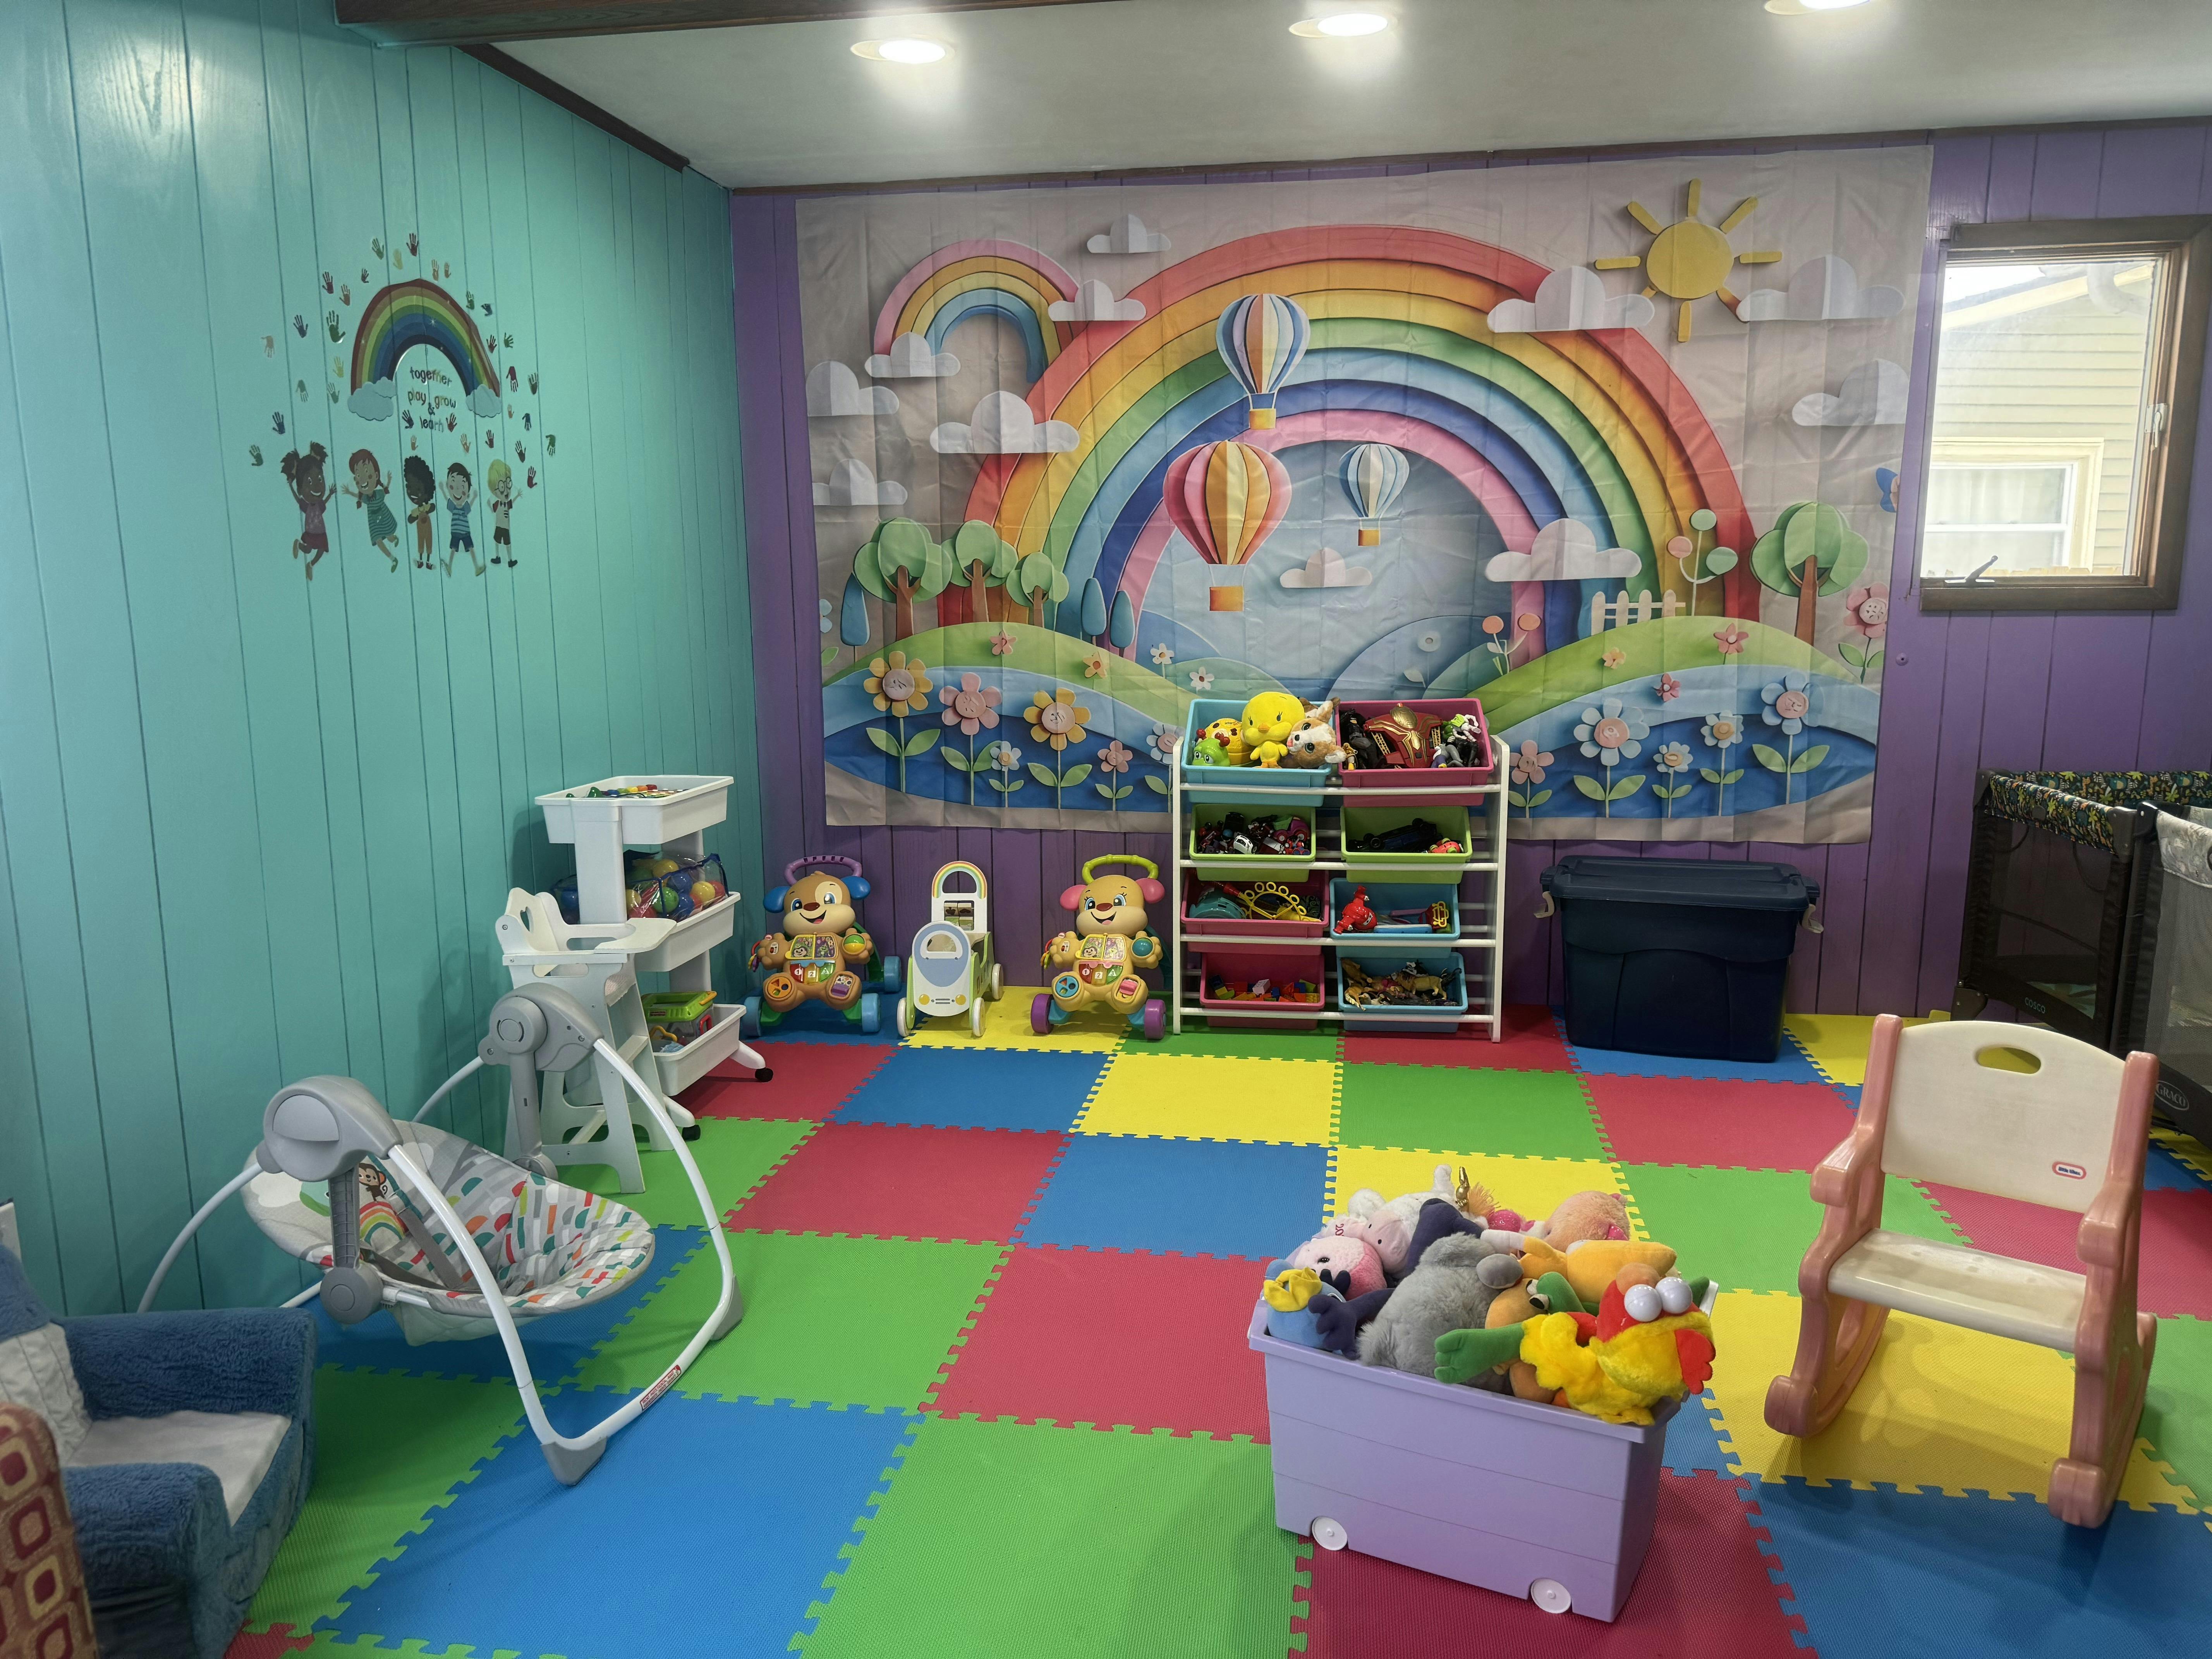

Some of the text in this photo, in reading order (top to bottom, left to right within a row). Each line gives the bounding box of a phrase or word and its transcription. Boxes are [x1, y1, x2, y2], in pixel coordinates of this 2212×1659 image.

[408, 388, 457, 409] play grow
[428, 402, 435, 416] &
[2025, 997, 2045, 1014] COSCO
[2156, 1083, 2186, 1107] GRACO
